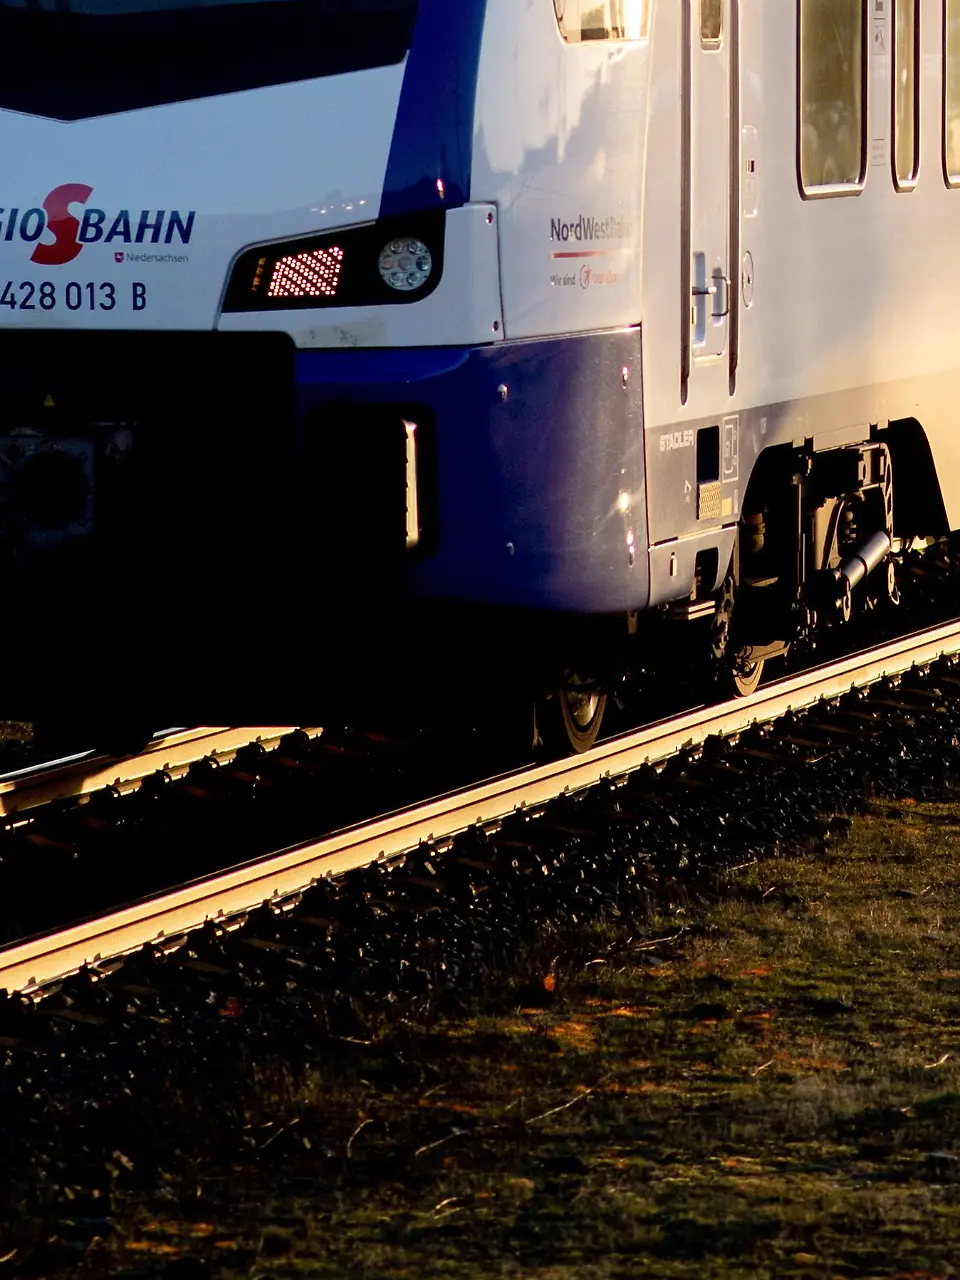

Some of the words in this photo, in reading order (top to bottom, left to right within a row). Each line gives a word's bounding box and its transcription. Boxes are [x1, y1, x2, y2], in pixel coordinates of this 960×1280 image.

[126, 252, 189, 263] Niedersachsen
[0, 281, 56, 310] 428
[65, 281, 116, 311] 013
[132, 282, 147, 311] B
[660, 429, 694, 452] STADLER
